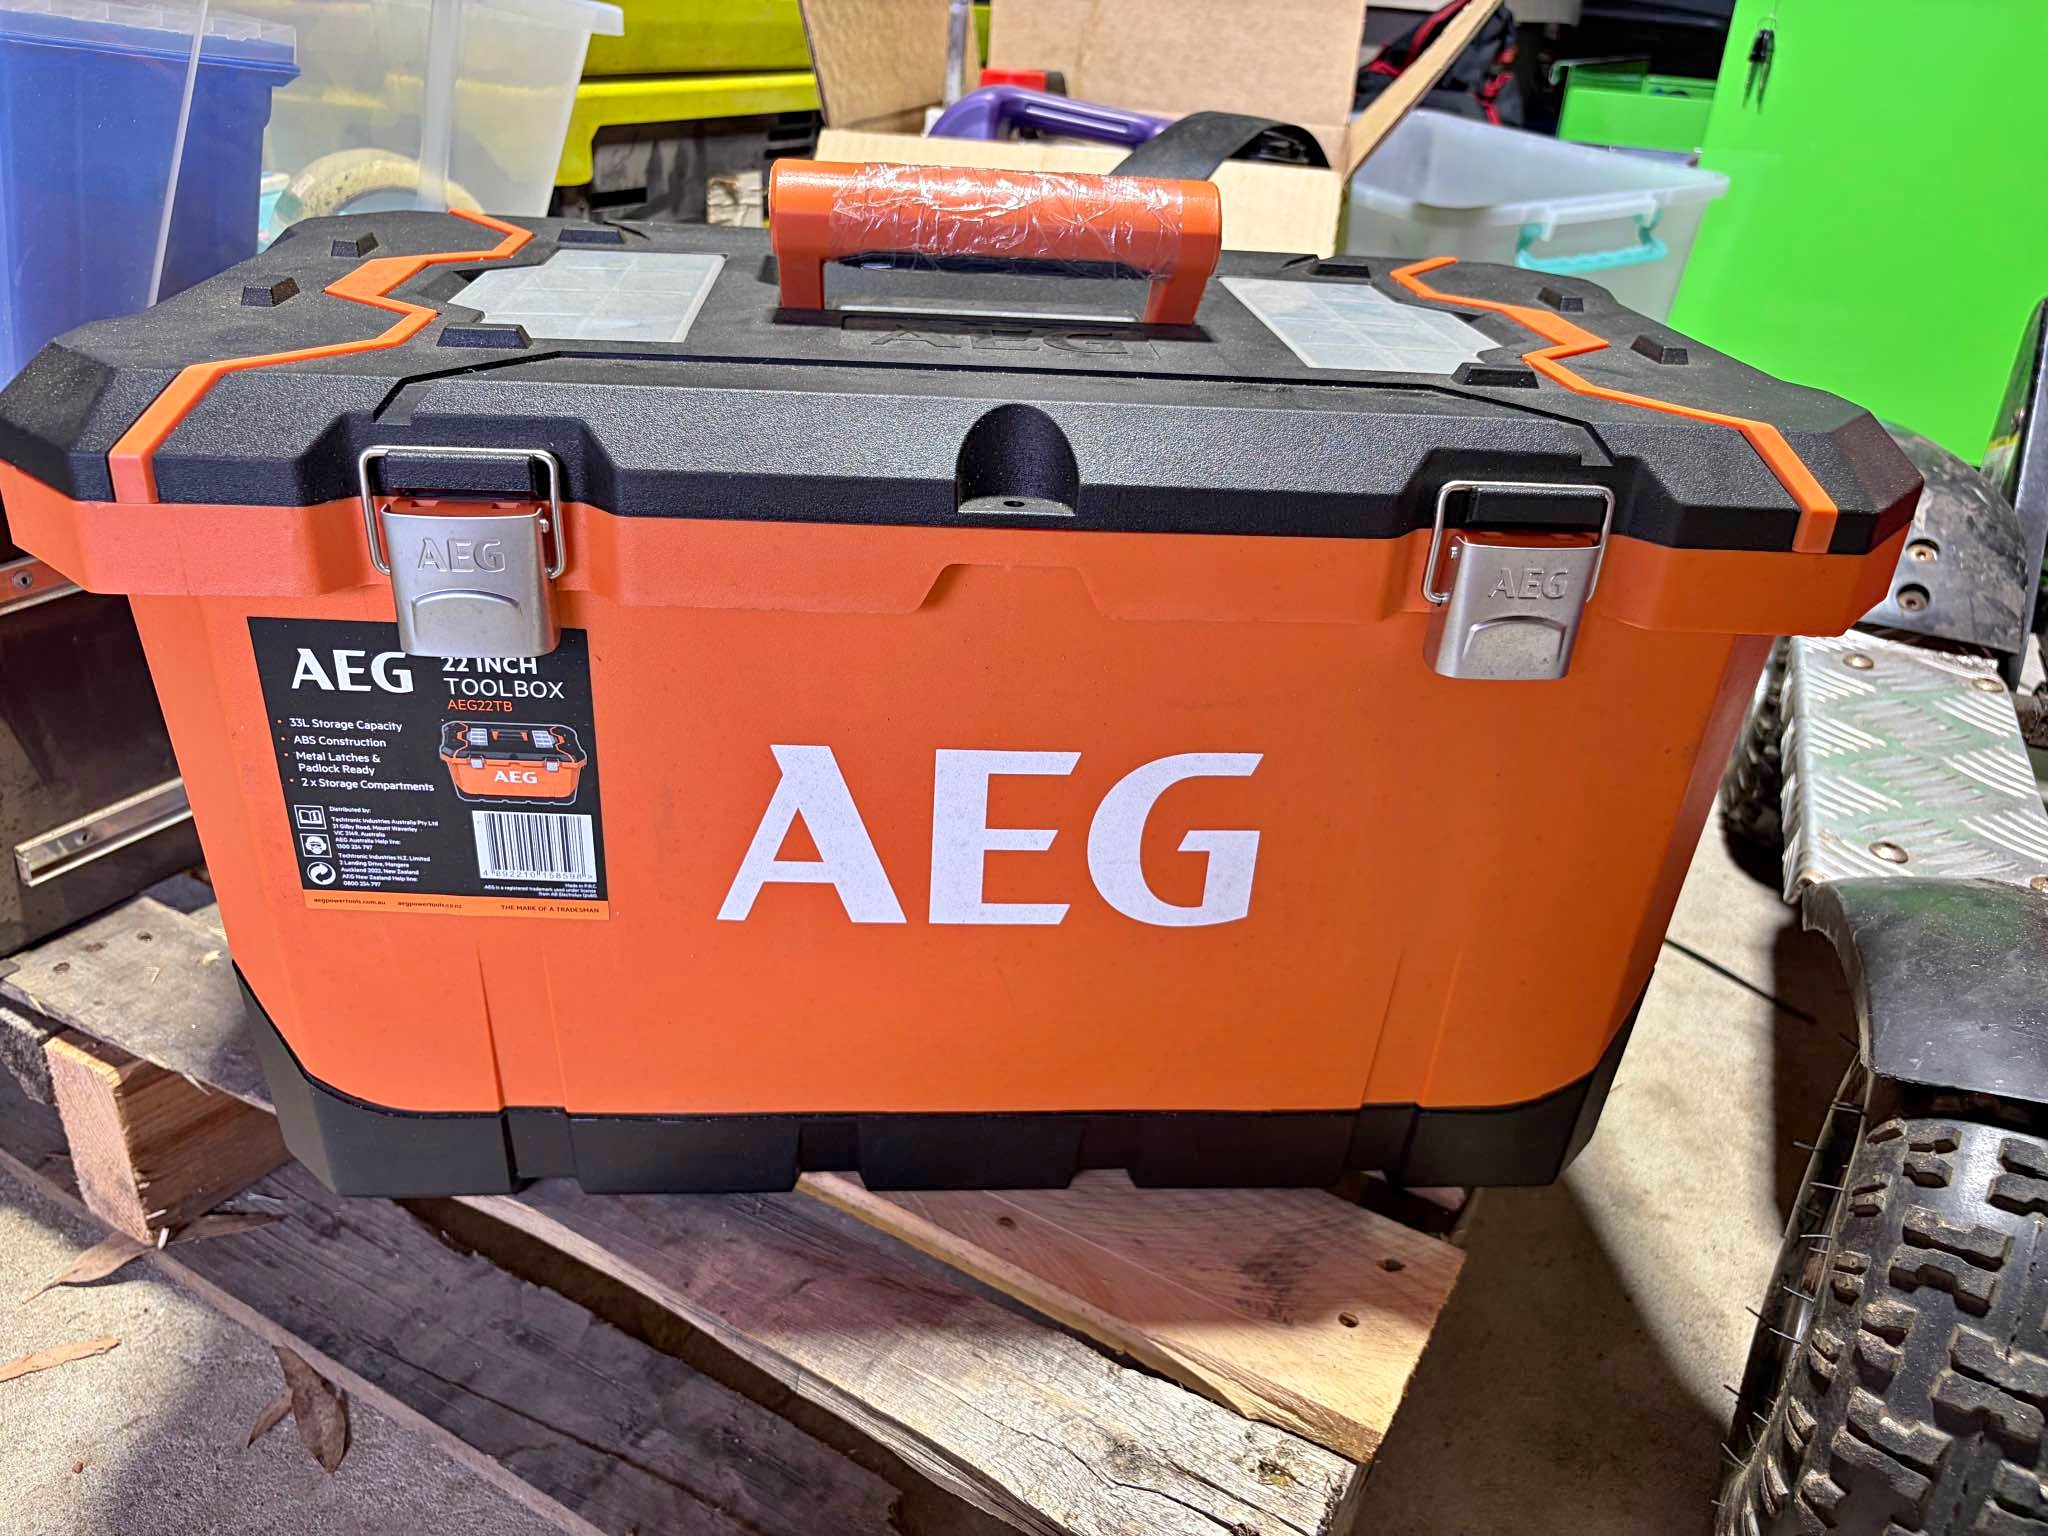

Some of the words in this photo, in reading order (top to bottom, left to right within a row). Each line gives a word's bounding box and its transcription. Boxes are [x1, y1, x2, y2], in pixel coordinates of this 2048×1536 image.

[416, 536, 507, 573] AEG
[1487, 567, 1569, 600] AEG
[291, 647, 414, 694] AEG
[440, 656, 470, 672] 22
[477, 656, 538, 675] INCH
[443, 677, 565, 699] TOOLBOX
[447, 699, 513, 712] AEG22TB
[289, 717, 310, 728] 33L
[311, 718, 354, 731] Storage
[356, 720, 403, 733] Capacity
[293, 735, 317, 745] ABS
[318, 736, 387, 748] Construction
[295, 751, 326, 761] Metal
[327, 752, 370, 763] Latches
[372, 754, 381, 763] &
[298, 763, 340, 774] Padlock
[342, 765, 376, 776] Ready
[493, 770, 538, 784] AEG
[301, 778, 308, 787] 2
[319, 778, 358, 790] Storage
[360, 780, 435, 792] Compartments
[717, 744, 1264, 927] AEG
